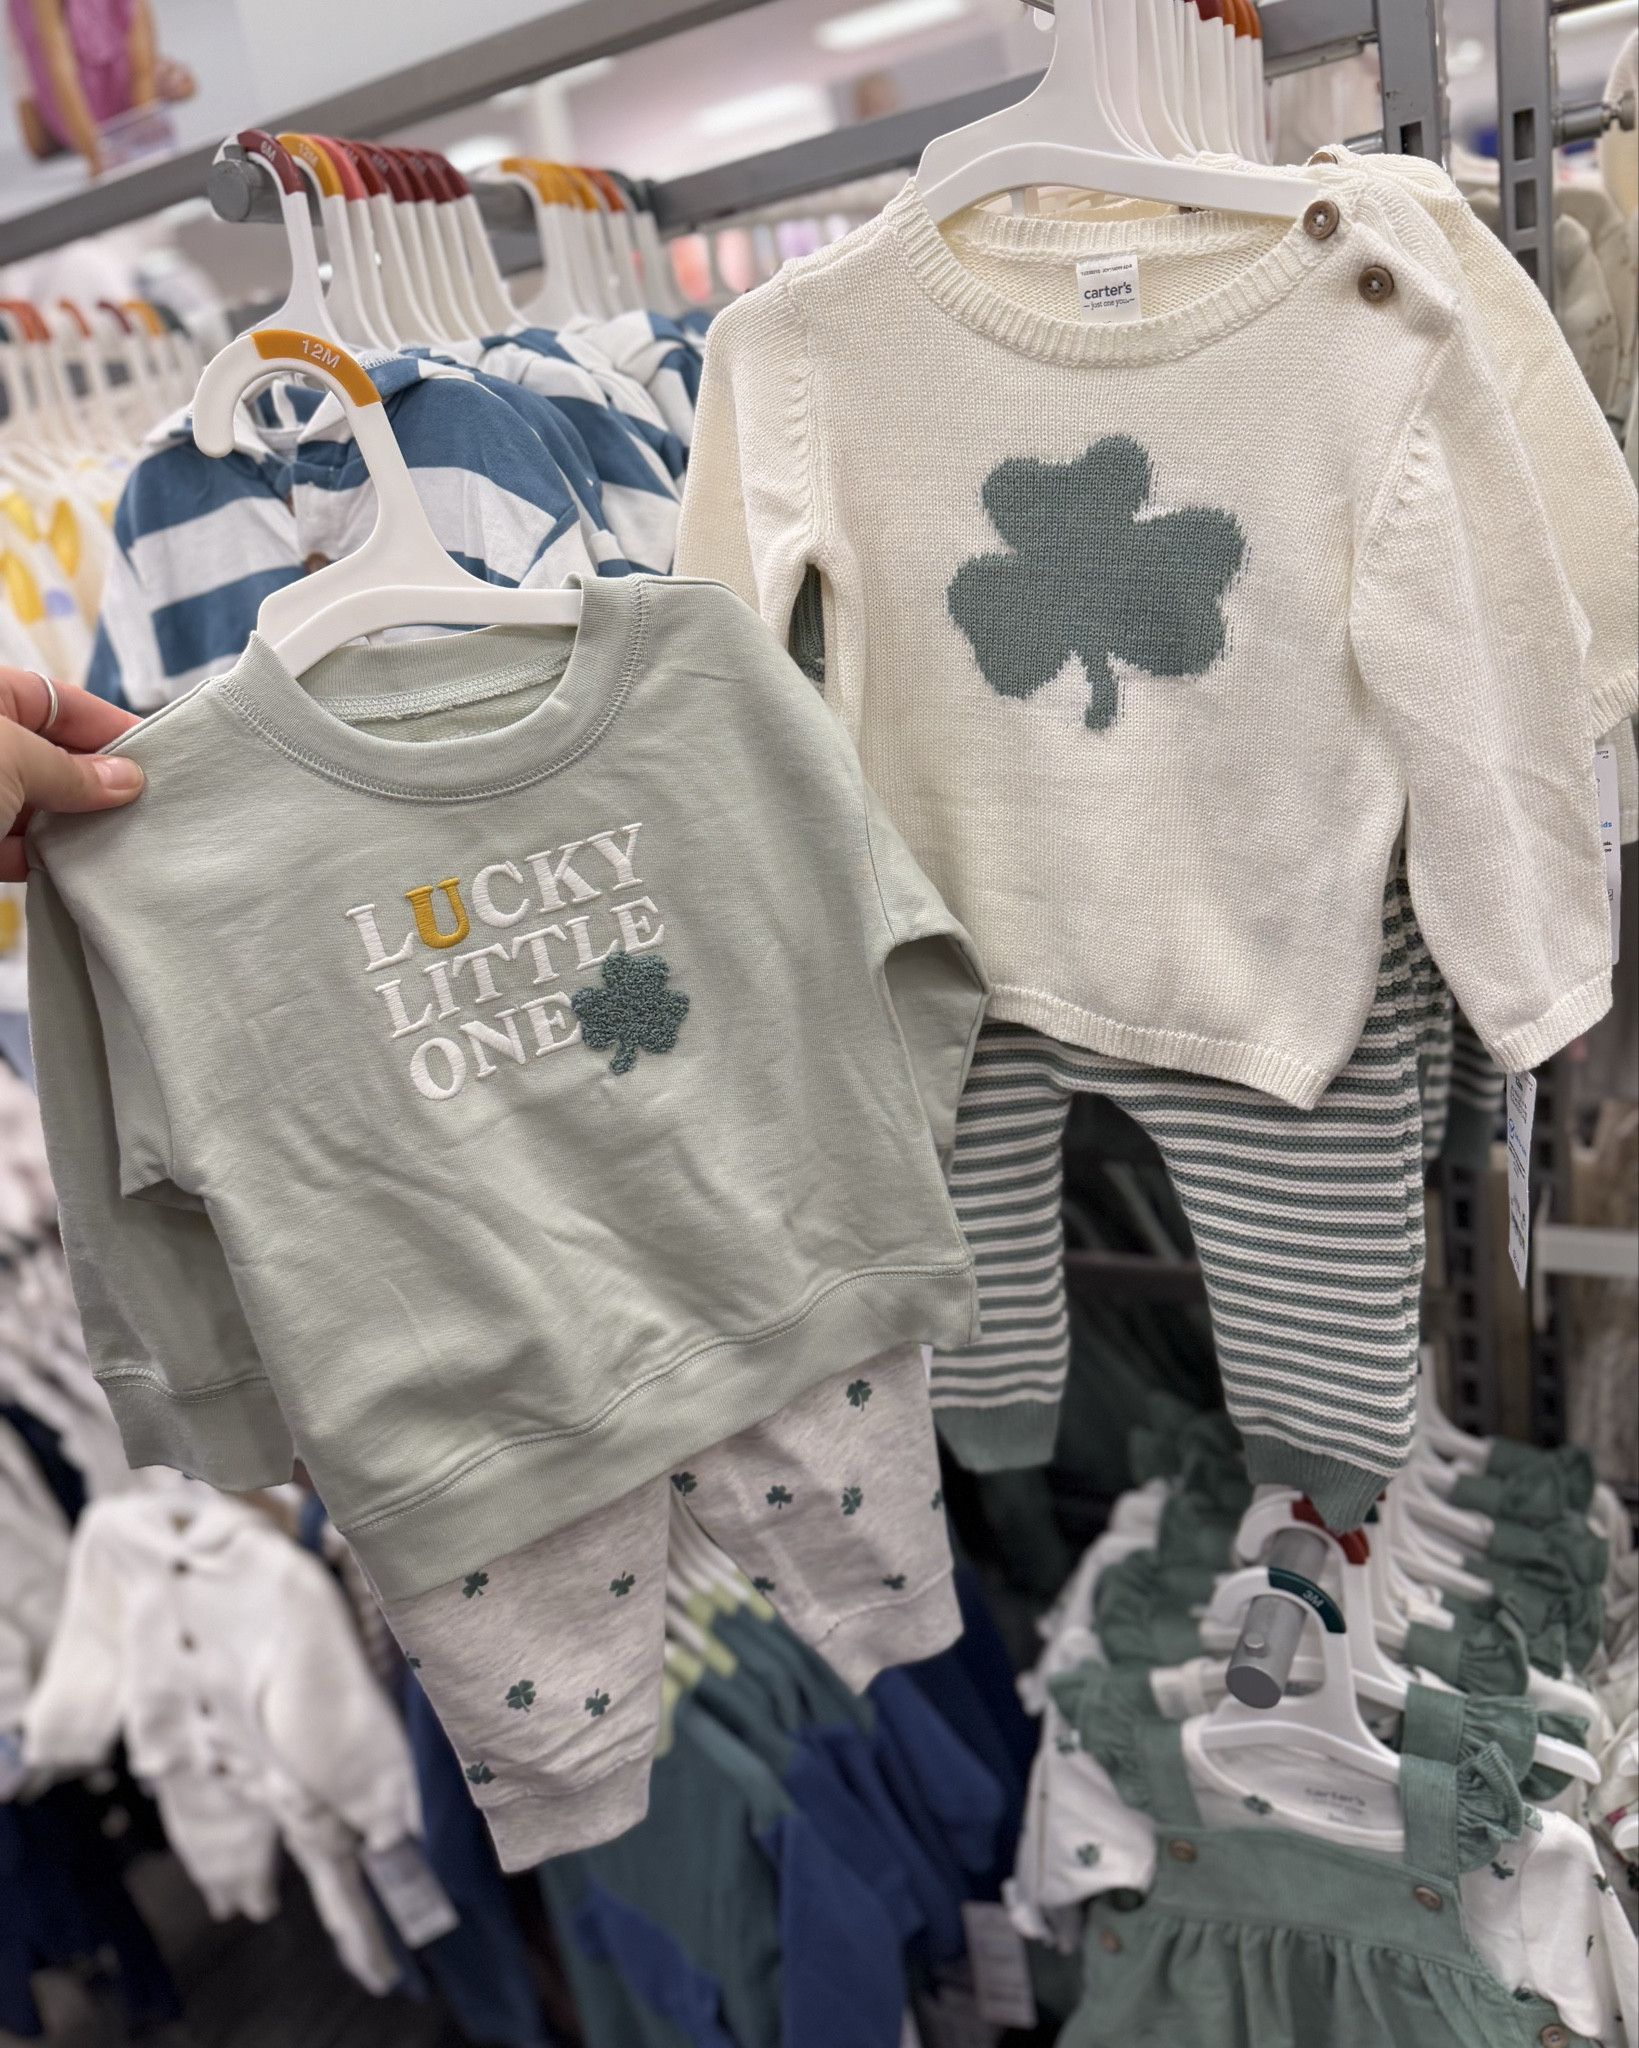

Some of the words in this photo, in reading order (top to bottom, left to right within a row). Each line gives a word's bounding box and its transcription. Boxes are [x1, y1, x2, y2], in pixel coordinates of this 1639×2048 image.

[1083, 281, 1132, 300] carter's
[1091, 301, 1103, 310] just
[1103, 299, 1115, 307] one
[302, 339, 341, 369] 12M
[345, 822, 643, 972] LUCKY
[375, 896, 665, 1038] LITTLE
[409, 991, 582, 1100] ONE
[1302, 1589, 1325, 1608] 3M
